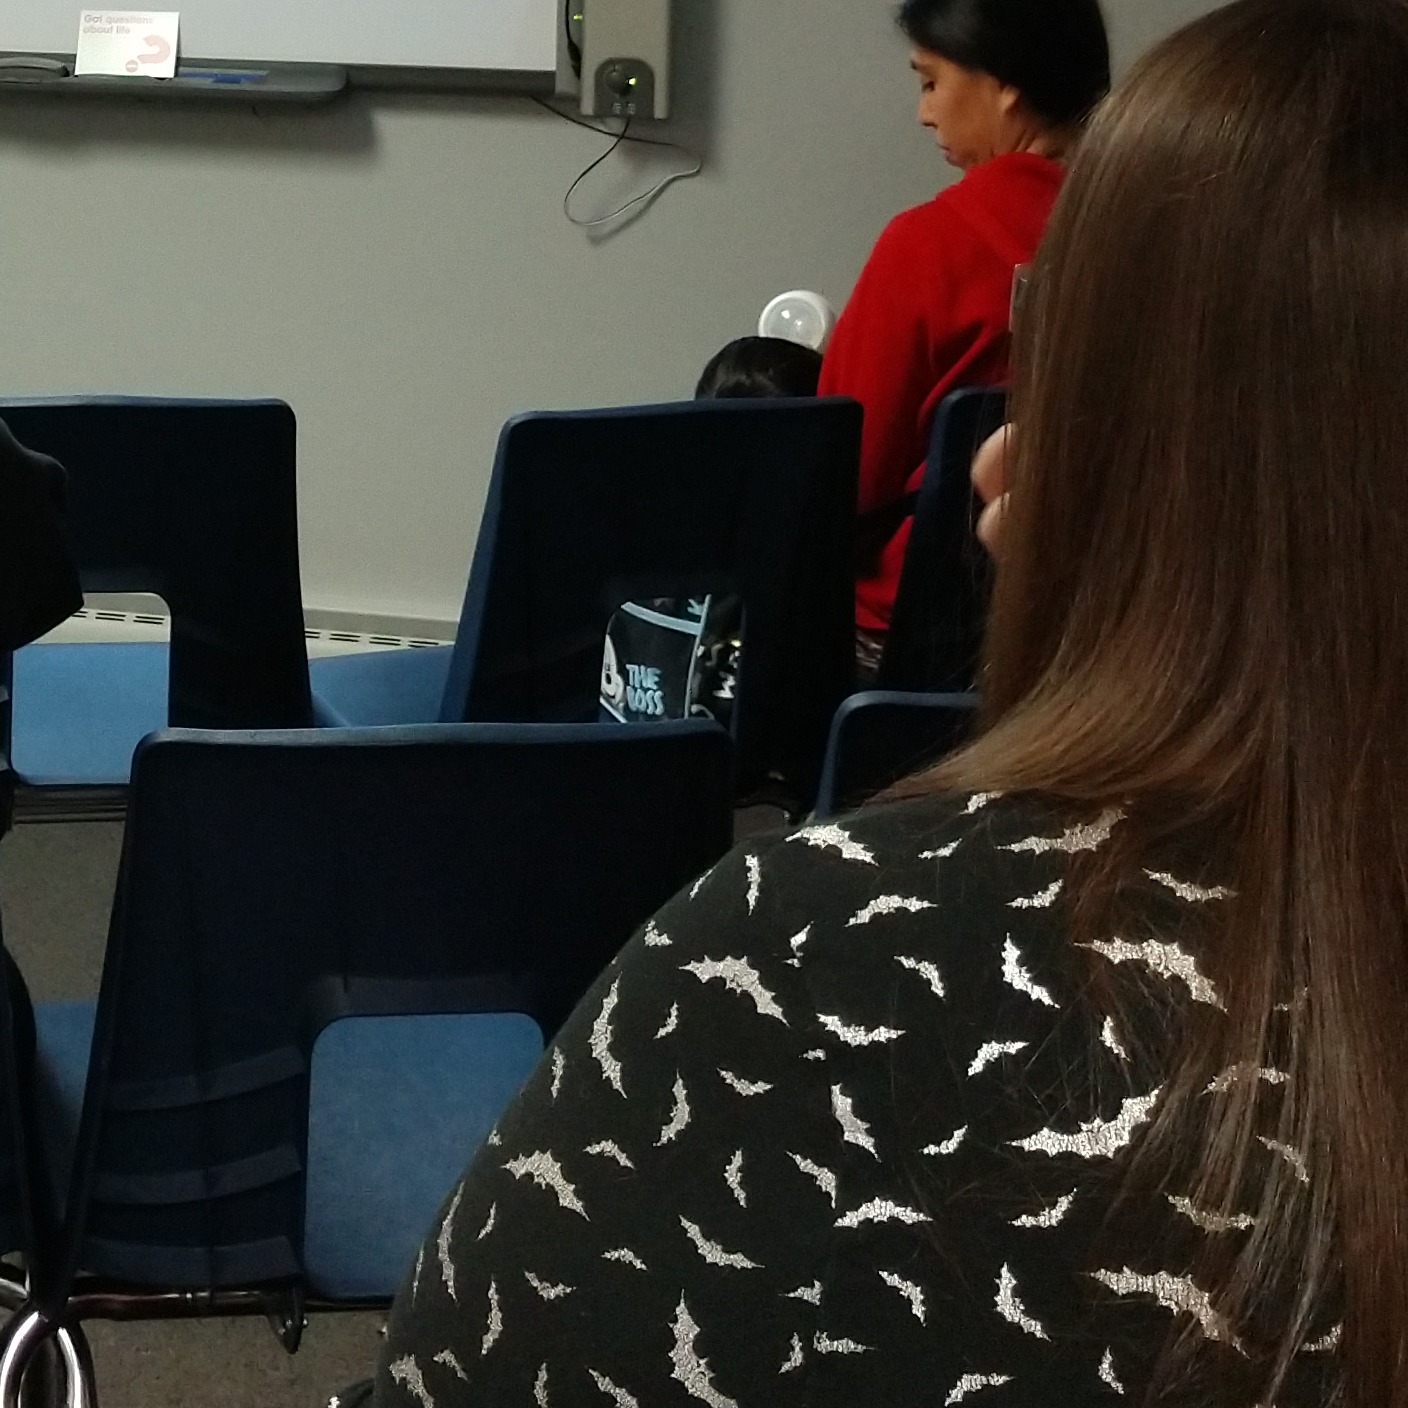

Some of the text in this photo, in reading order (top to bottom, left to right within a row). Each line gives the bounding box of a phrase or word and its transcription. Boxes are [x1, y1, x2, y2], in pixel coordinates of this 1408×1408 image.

[84, 14, 103, 23] Got
[83, 25, 113, 34] about
[625, 664, 661, 690] THE
